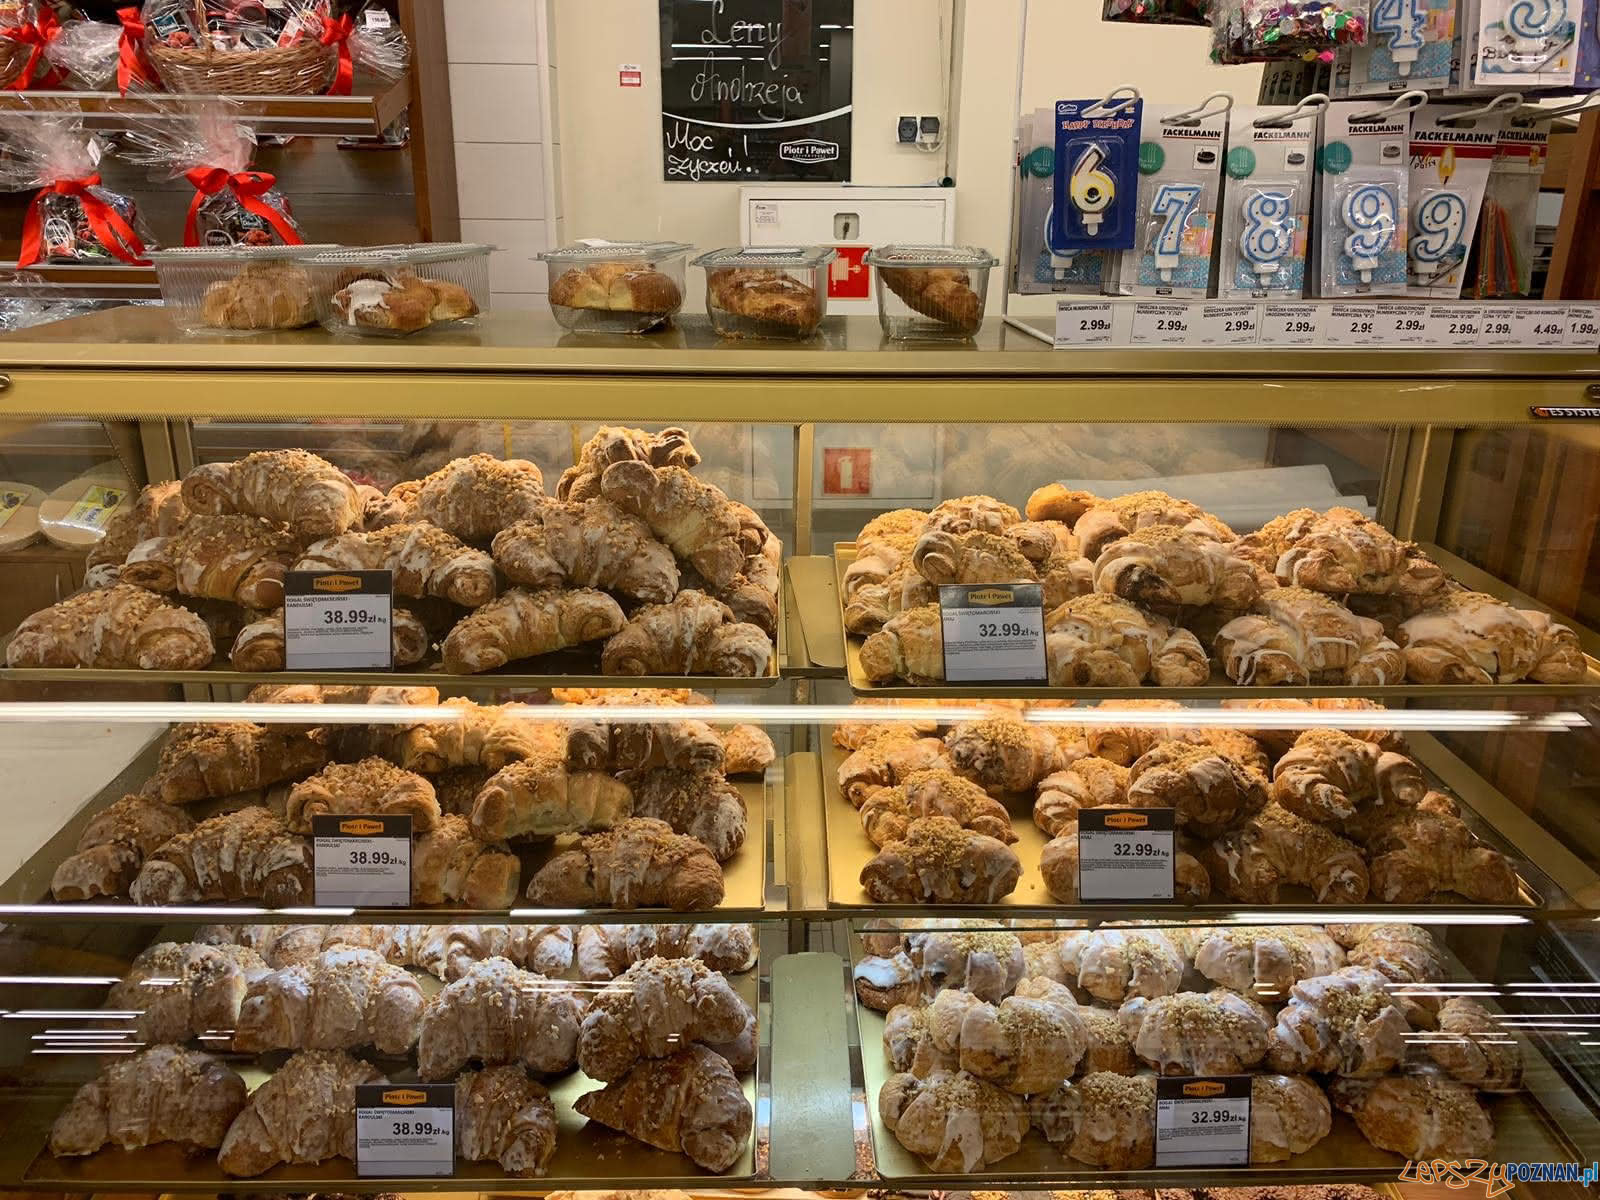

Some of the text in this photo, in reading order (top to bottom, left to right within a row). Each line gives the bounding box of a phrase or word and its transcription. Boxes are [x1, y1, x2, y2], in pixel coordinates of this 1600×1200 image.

[1163, 128, 1221, 138] FACKELMANN
[1253, 131, 1311, 139] FACKELMANN
[1348, 124, 1404, 134] FACKELMANN
[666, 121, 714, 152] Moc
[1414, 131, 1494, 143] FACKELMANN
[1497, 130, 1547, 142] FACKELMANN
[783, 145, 805, 154] Piotr
[1151, 184, 1201, 256] 7
[1342, 185, 1396, 259] 9
[1241, 192, 1292, 264] 8
[1409, 192, 1466, 262] 9
[1157, 319, 1187, 331] 2.99zł
[1225, 320, 1255, 331] 2.99zł
[1285, 321, 1315, 332] 2.99zł
[1396, 319, 1425, 331] 2.99zł
[1449, 323, 1478, 334] 2.99zł
[1534, 324, 1563, 335] 4.49zł
[1571, 322, 1599, 335] 1.99zł
[1113, 843, 1160, 856] 32.99zł
[350, 851, 398, 865] 38.99zł
[1191, 1110, 1238, 1123] 32.99zł
[393, 1122, 440, 1135] 38.99zł
